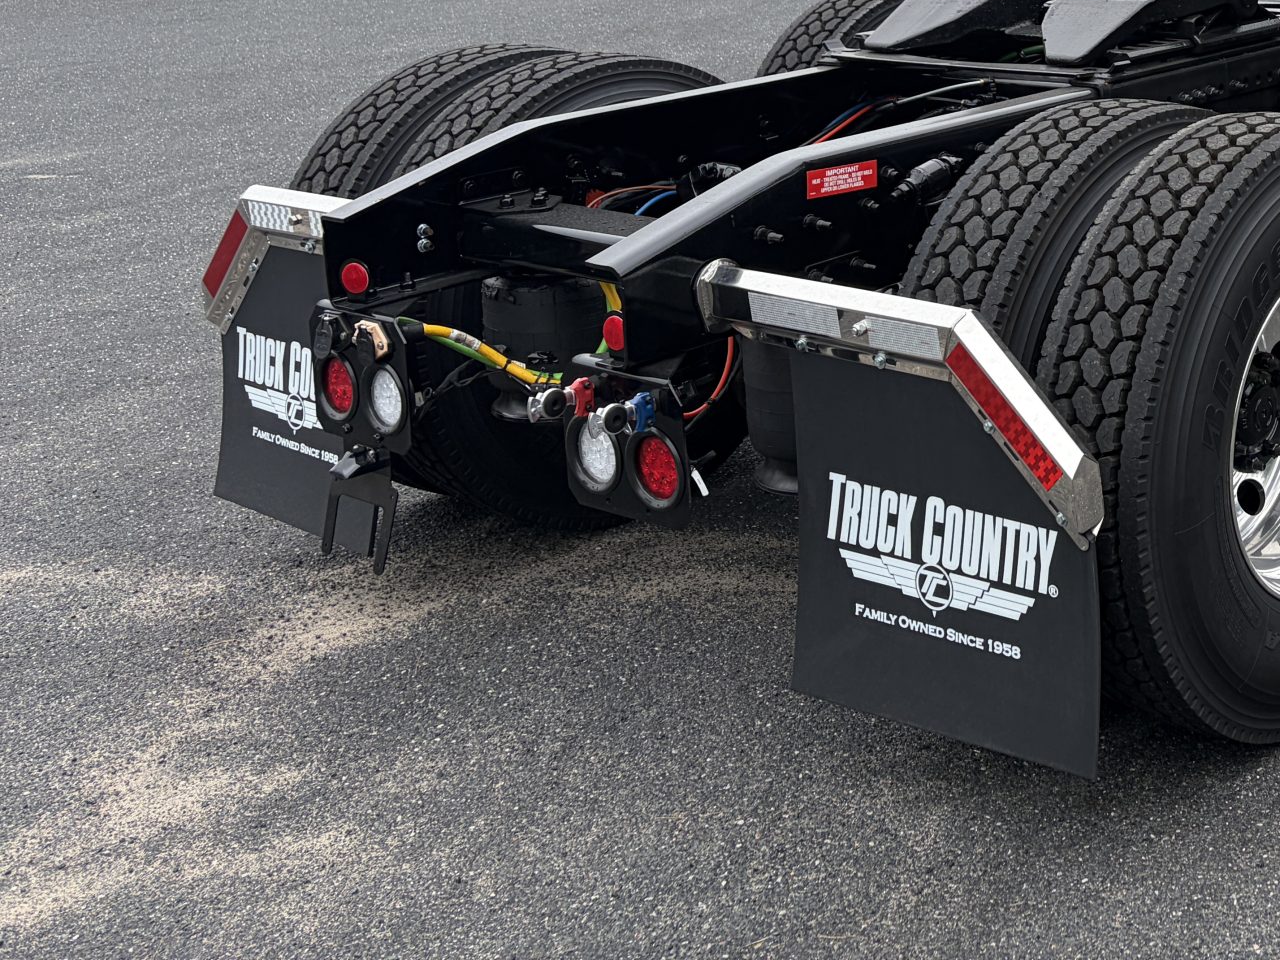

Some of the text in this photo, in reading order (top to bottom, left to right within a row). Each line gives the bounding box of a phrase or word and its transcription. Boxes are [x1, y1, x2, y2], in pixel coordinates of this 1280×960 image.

[825, 165, 859, 176] IMPORTANT
[237, 326, 286, 391] TRUCK
[252, 426, 339, 465] FAMILY OWNED SINCE 1958
[827, 471, 1058, 596] TRUCK COUNTRY
[855, 603, 1021, 660] FAMILY OWNED SINCE 1958
